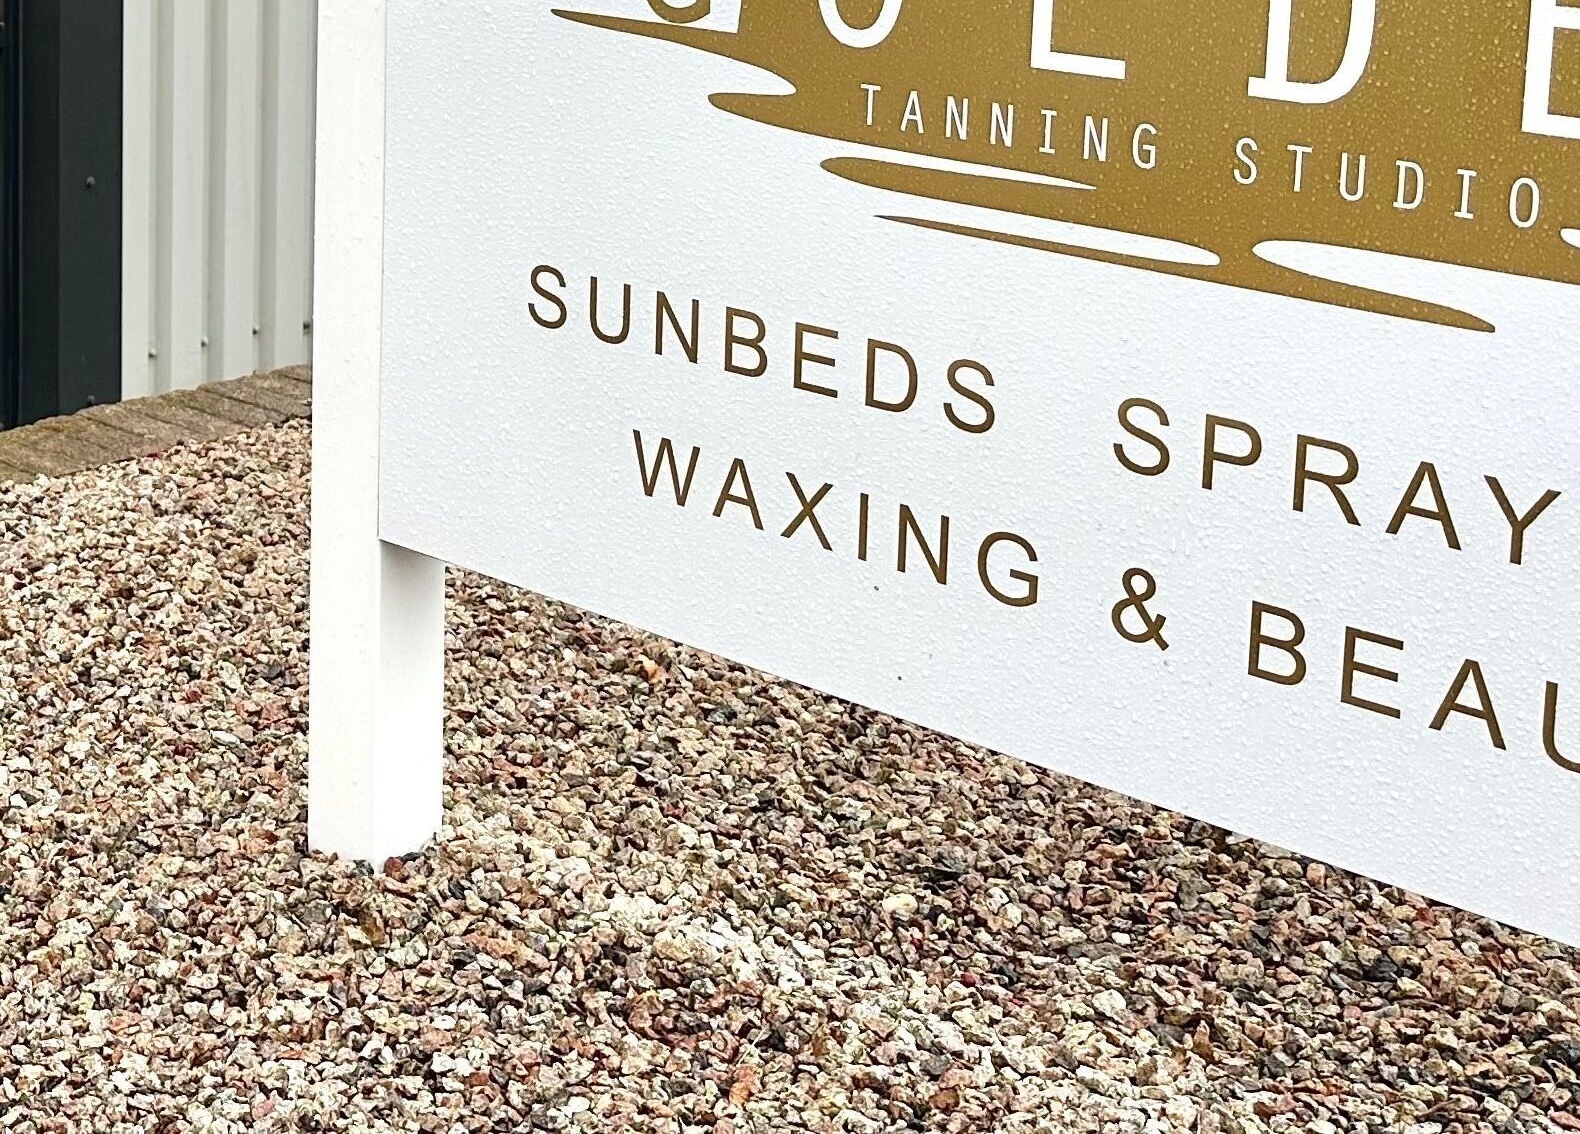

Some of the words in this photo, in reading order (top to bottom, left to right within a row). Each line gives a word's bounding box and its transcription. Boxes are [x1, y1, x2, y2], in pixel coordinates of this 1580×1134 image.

[860, 82, 1160, 170] TANNING
[1232, 136, 1542, 229] STUDIO
[527, 264, 997, 435] SUNBEDS
[1112, 396, 1564, 567] SPRAY
[631, 427, 1040, 609] WAXING
[1110, 566, 1171, 653] &
